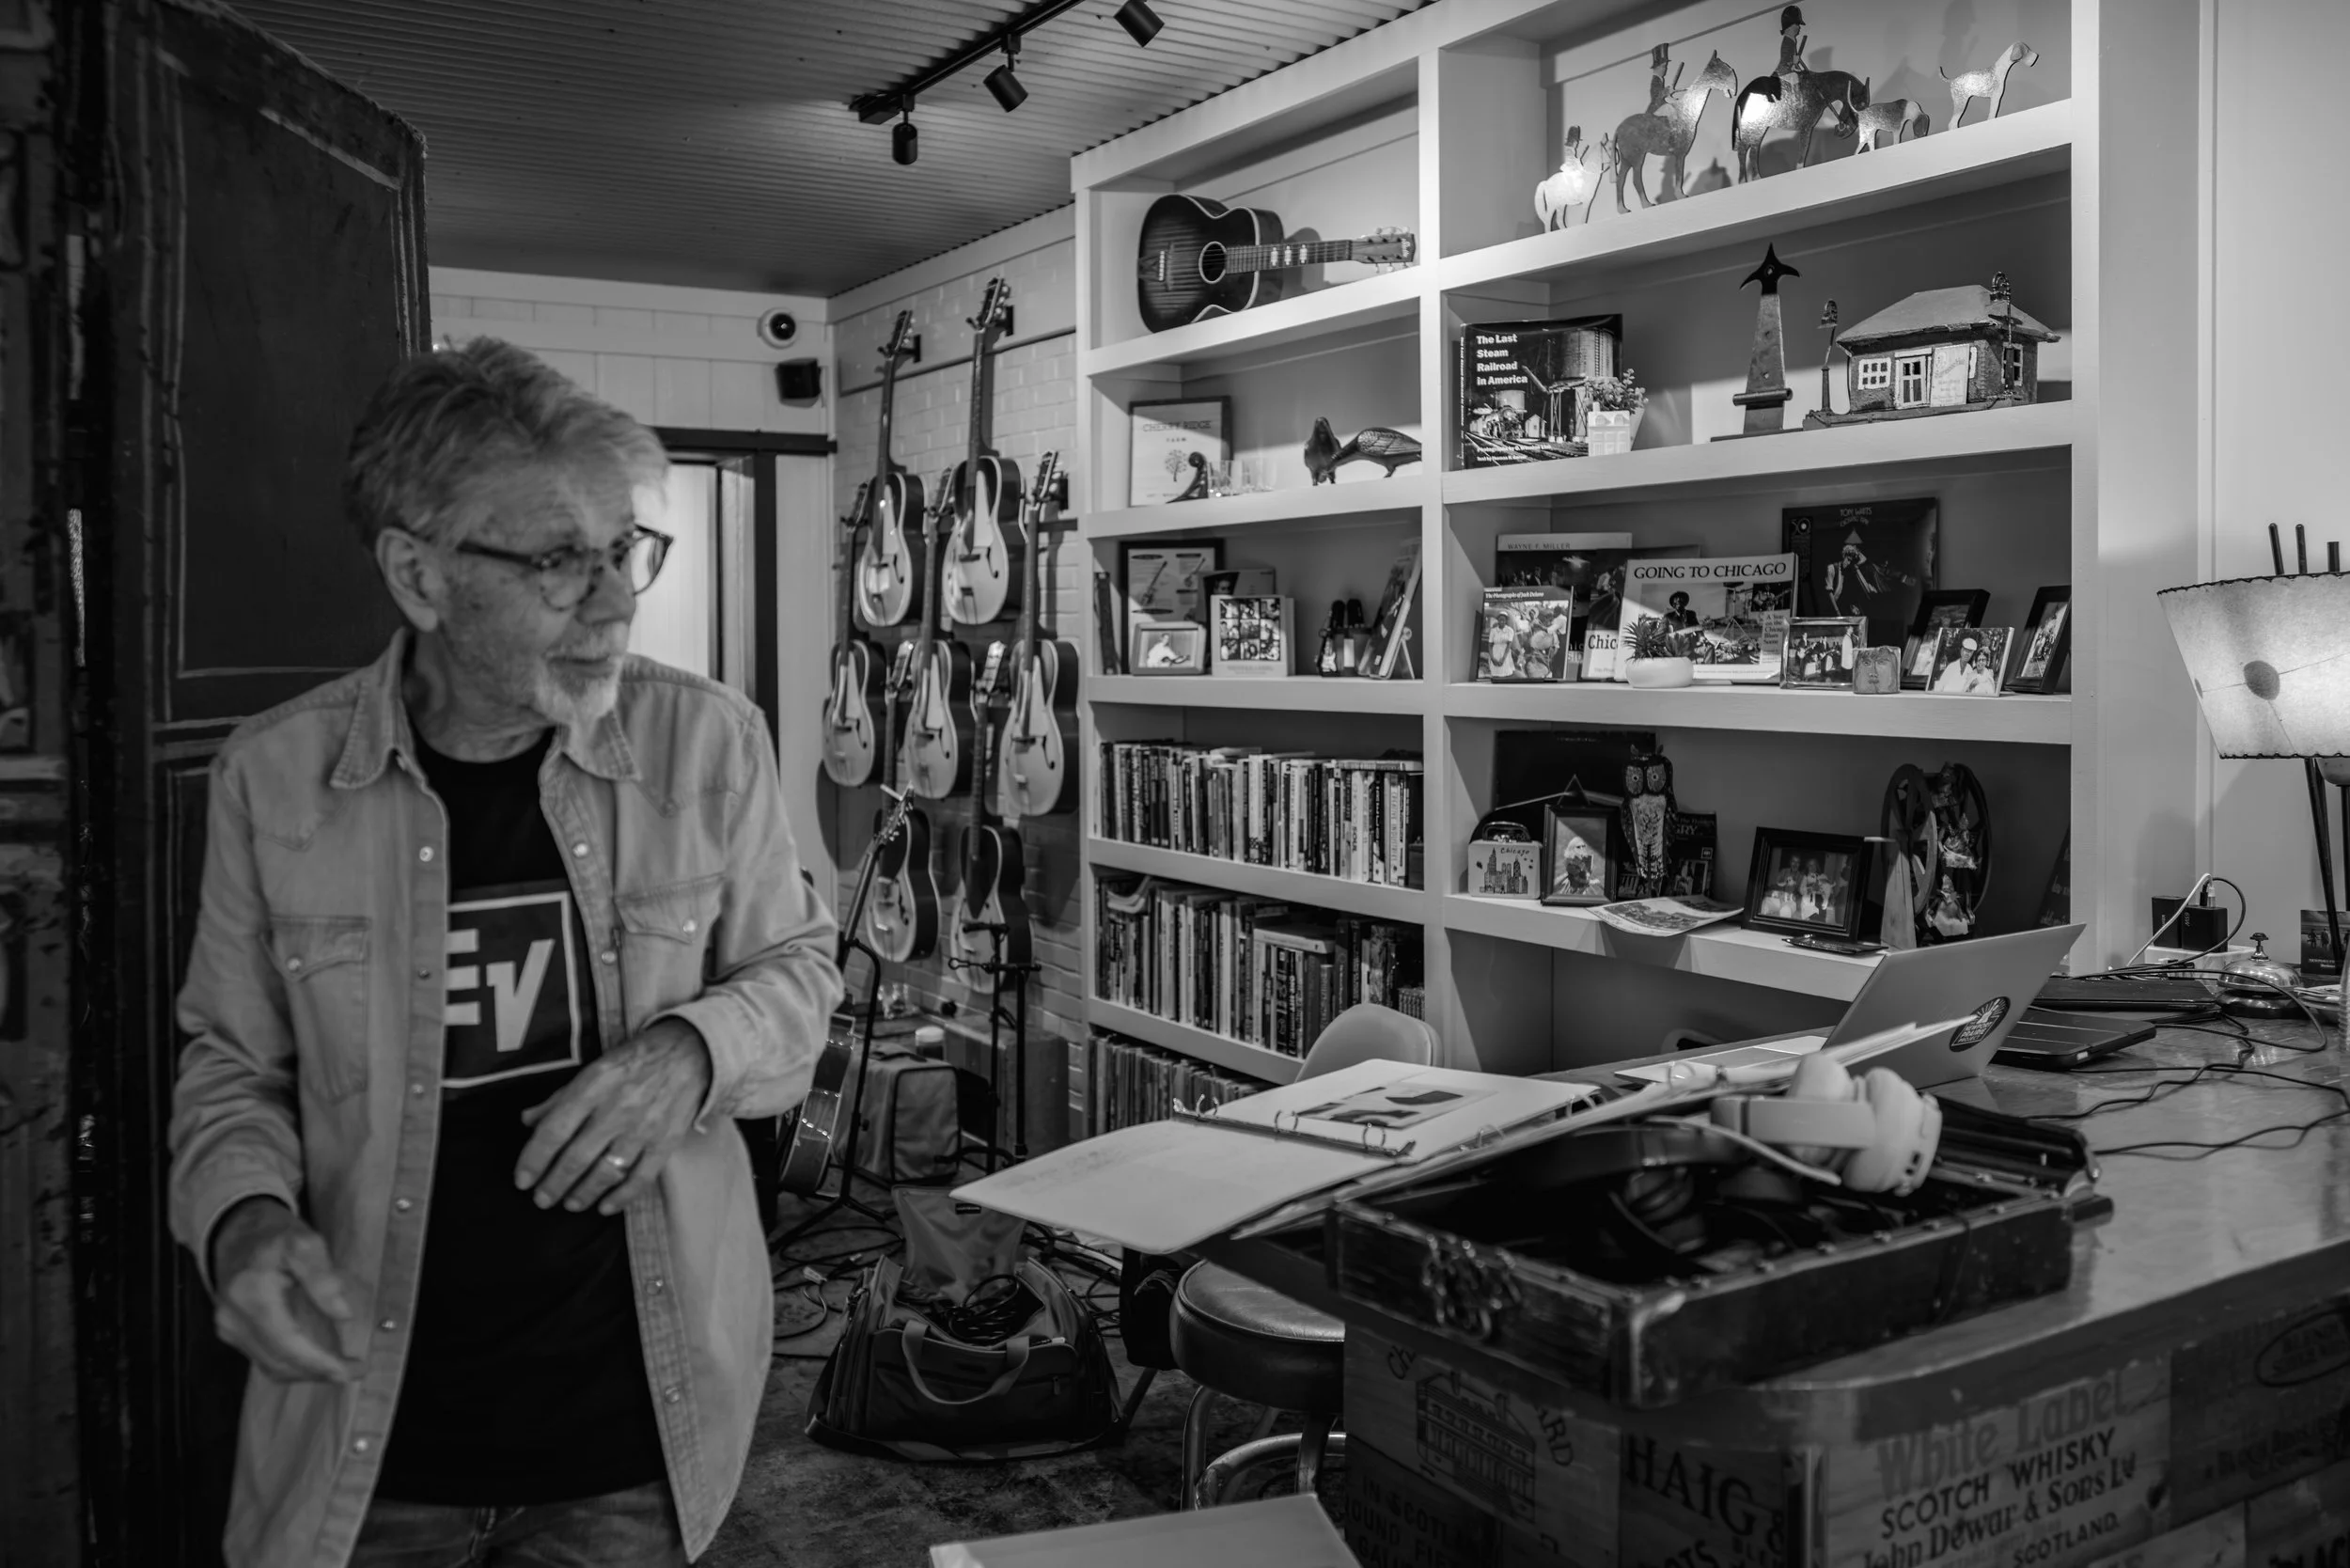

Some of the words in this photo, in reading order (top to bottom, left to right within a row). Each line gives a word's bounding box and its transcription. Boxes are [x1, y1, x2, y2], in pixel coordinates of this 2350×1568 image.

[1476, 336, 1495, 344] The
[1496, 334, 1517, 343] Last
[1477, 349, 1509, 358] Steam
[1477, 362, 1518, 371] Railroad
[1477, 376, 1486, 385] in
[1488, 374, 1528, 384] America
[1634, 566, 1684, 579] GOING
[1689, 566, 1710, 578] TO
[1714, 563, 1786, 577] CHICAGO
[1589, 635, 1618, 650] Chic
[1625, 1434, 1757, 1536] HAIG
[1881, 1472, 1991, 1541] SCOTCH
[2005, 1425, 2116, 1491] WHISKY
[1930, 1502, 2018, 1560] Dewar
[2023, 1490, 2040, 1524] &
[2047, 1466, 2106, 1514] Sons
